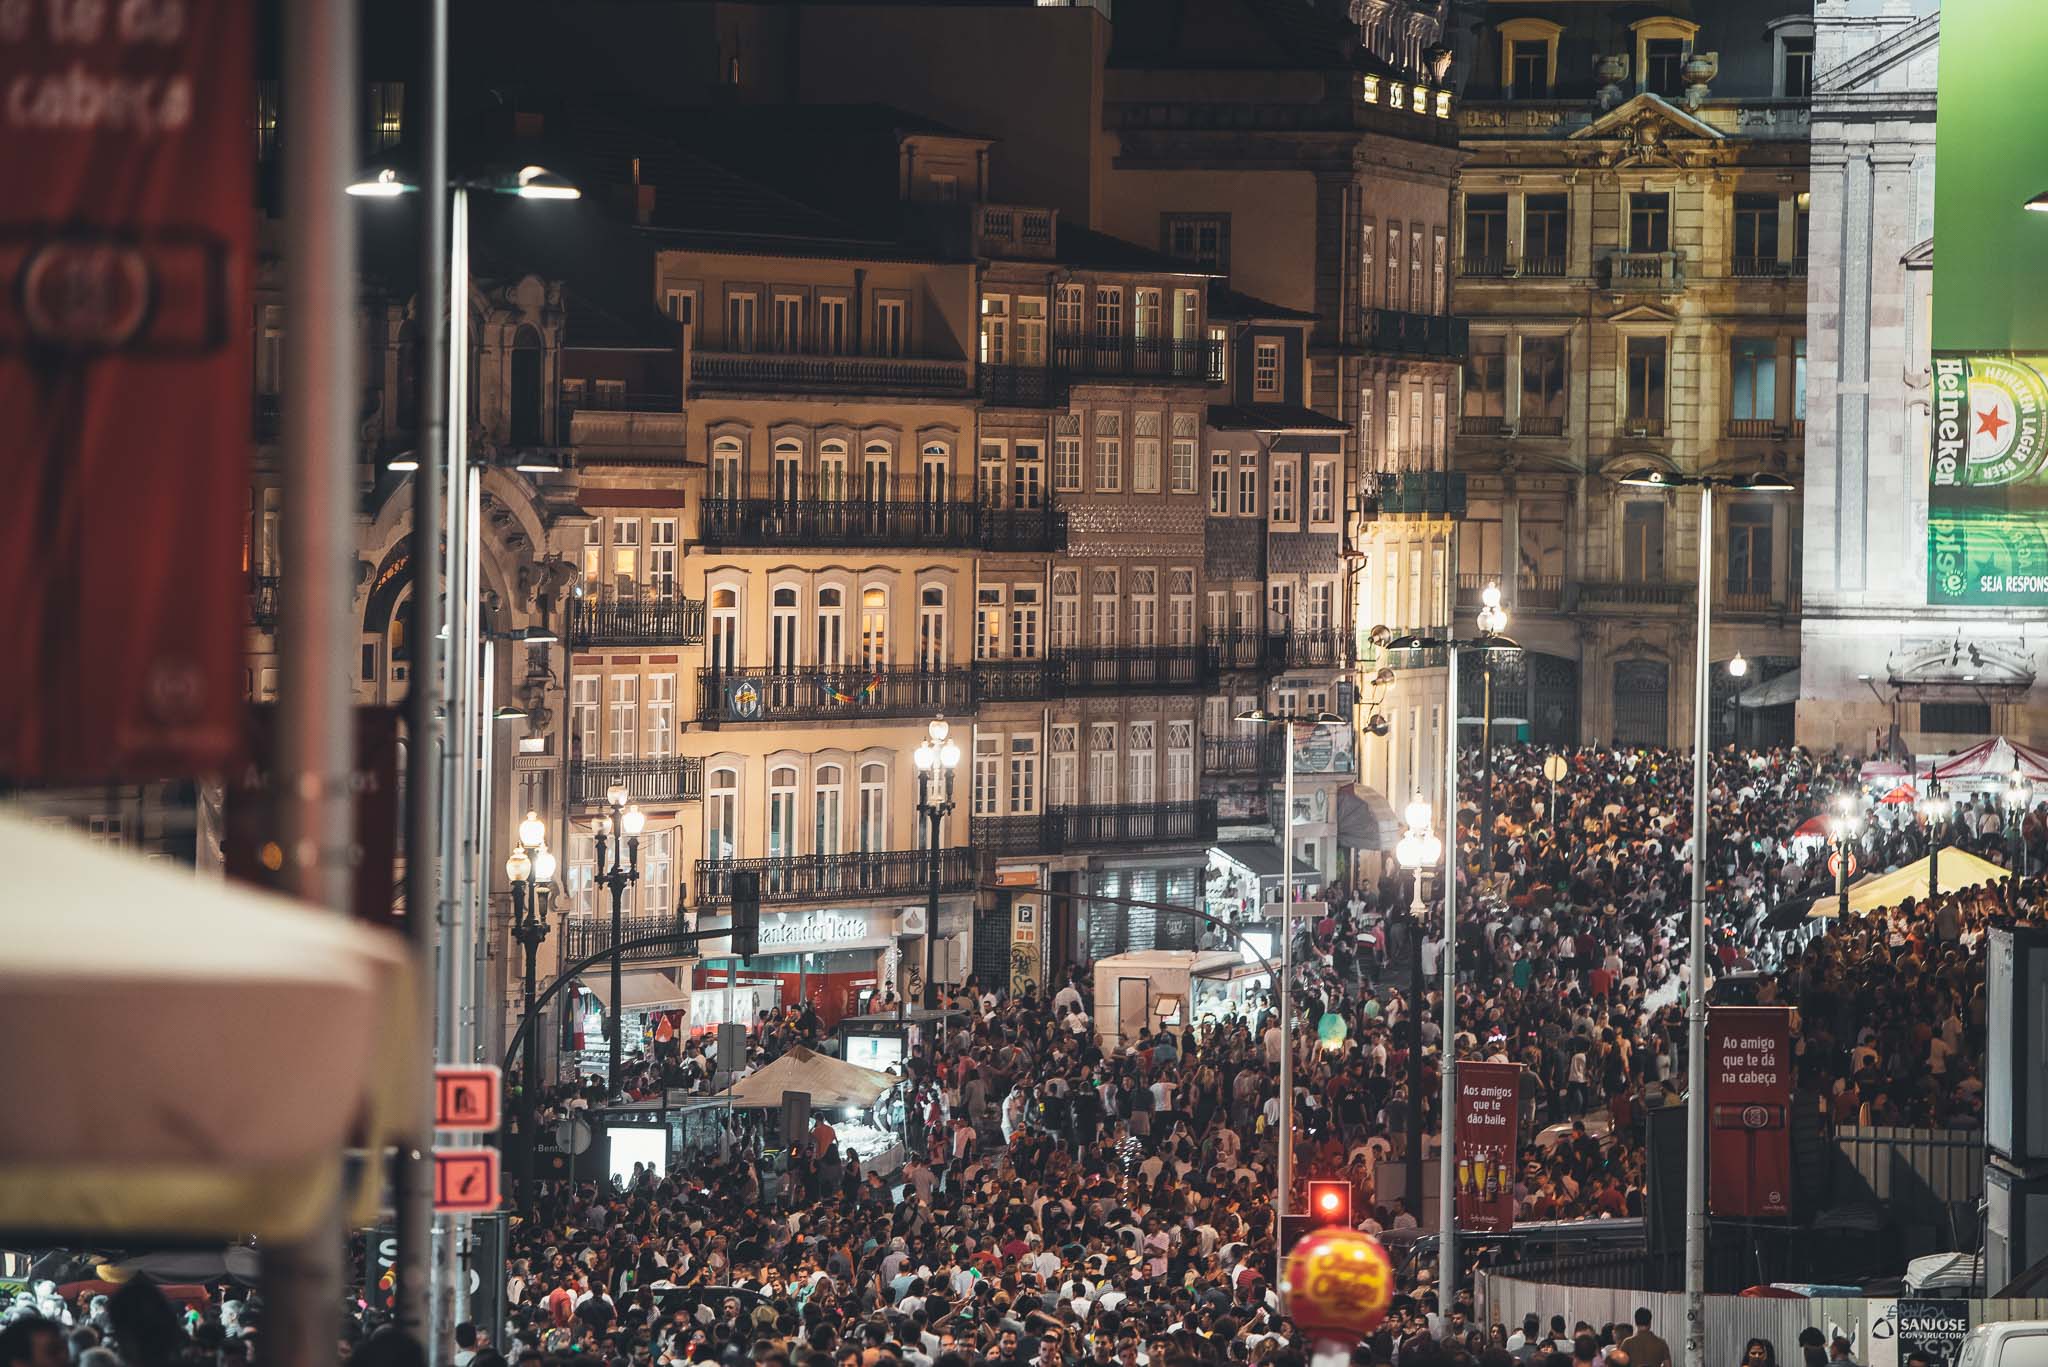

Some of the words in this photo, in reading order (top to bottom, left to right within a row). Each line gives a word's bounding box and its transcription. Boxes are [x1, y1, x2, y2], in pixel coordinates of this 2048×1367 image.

[1934, 359, 1965, 486] Heineken
[2012, 418, 2037, 461] LAGER
[1983, 458, 2017, 479] BEER
[1980, 576, 2003, 592] SEJA
[1021, 910, 1030, 921] P
[1723, 1036, 1737, 1049] Ao
[1740, 1036, 1775, 1053] amigo
[1723, 1056, 1744, 1068] que
[1747, 1054, 1758, 1066] te
[1761, 1054, 1775, 1066] dá
[1722, 1073, 1736, 1083] na
[1739, 1072, 1777, 1087] cabeça
[1463, 1085, 1479, 1096] Aos
[1480, 1085, 1512, 1100] amigos
[1473, 1101, 1490, 1112] que
[1491, 1100, 1501, 1110] te
[1467, 1113, 1483, 1125] dão
[1484, 1113, 1506, 1125] baile
[1900, 1318, 1966, 1331] SANJOSE
